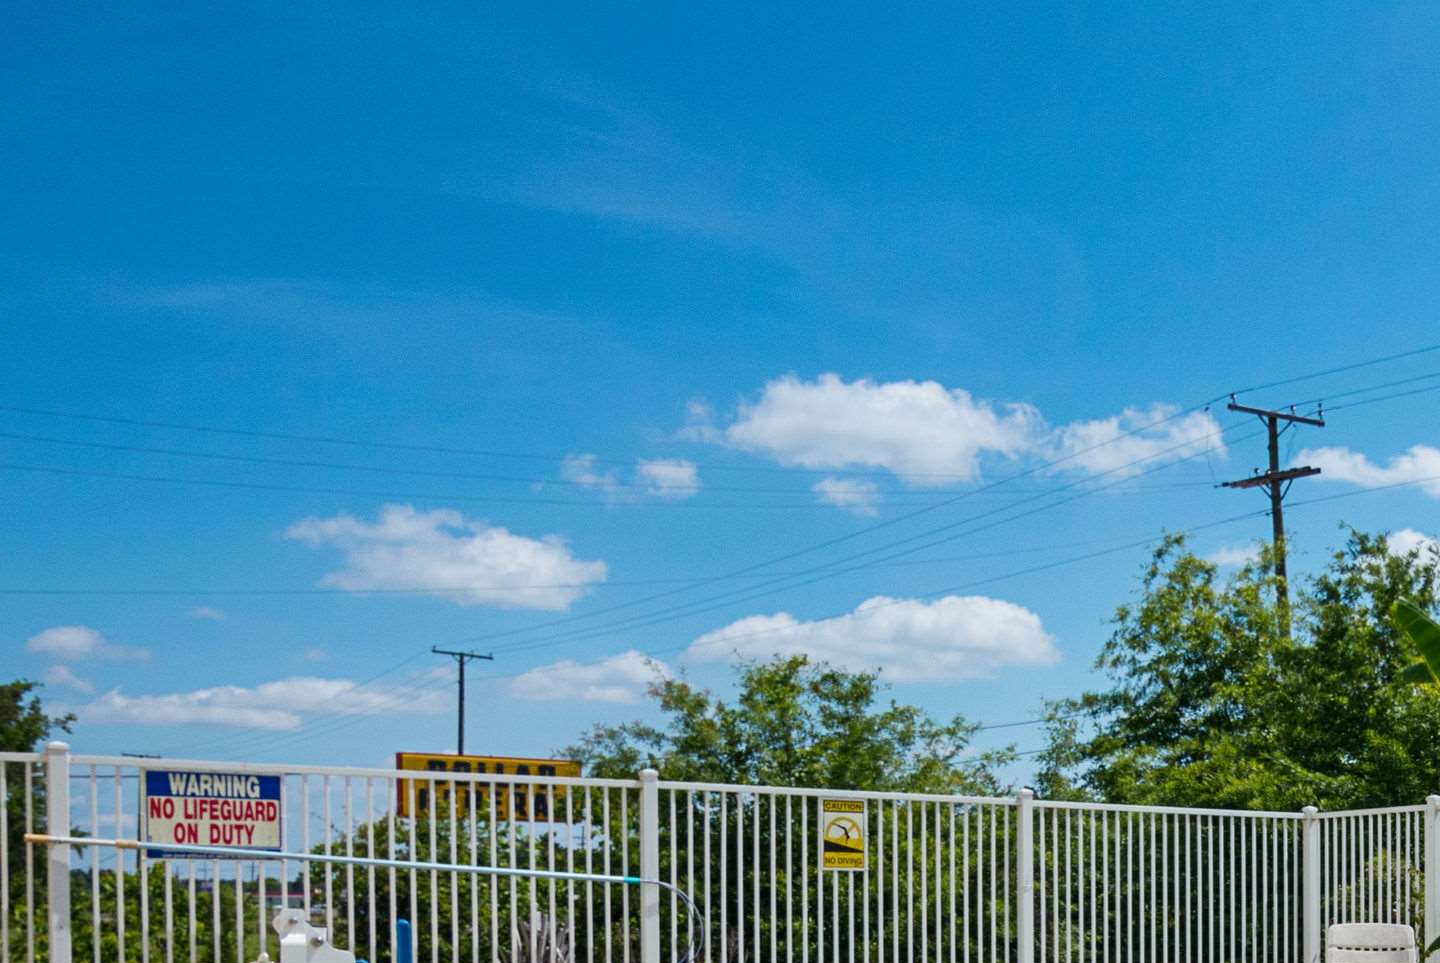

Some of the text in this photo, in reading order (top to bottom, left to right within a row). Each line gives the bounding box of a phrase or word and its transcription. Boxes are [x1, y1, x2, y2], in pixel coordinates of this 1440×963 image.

[168, 773, 260, 798] WARNING
[150, 798, 277, 822] NO LIFEGUARD
[825, 802, 862, 810] CAUTION
[174, 822, 256, 845] ON DUTY
[825, 856, 862, 865] NO DIVING
